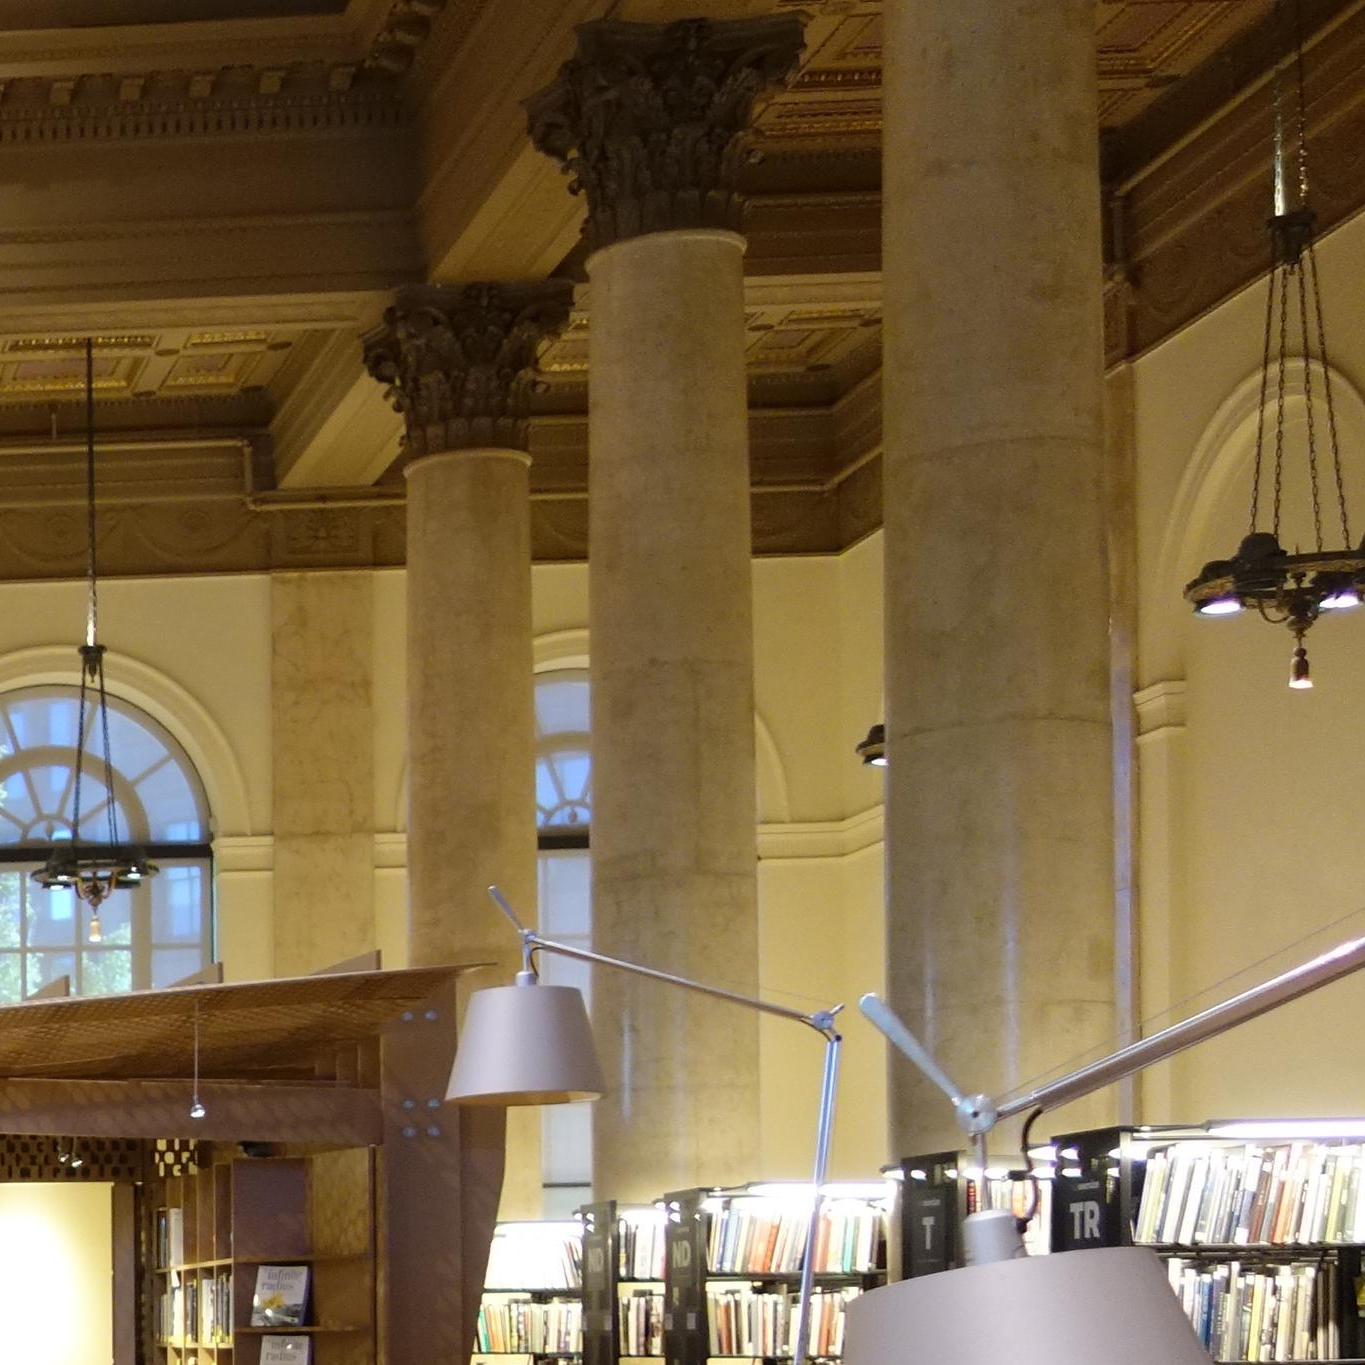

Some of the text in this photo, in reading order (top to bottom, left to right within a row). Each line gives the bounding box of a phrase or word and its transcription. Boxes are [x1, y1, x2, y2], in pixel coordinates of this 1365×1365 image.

[921, 1216, 936, 1250] T
[1069, 1200, 1100, 1240] TR
[672, 1240, 691, 1268] ND
